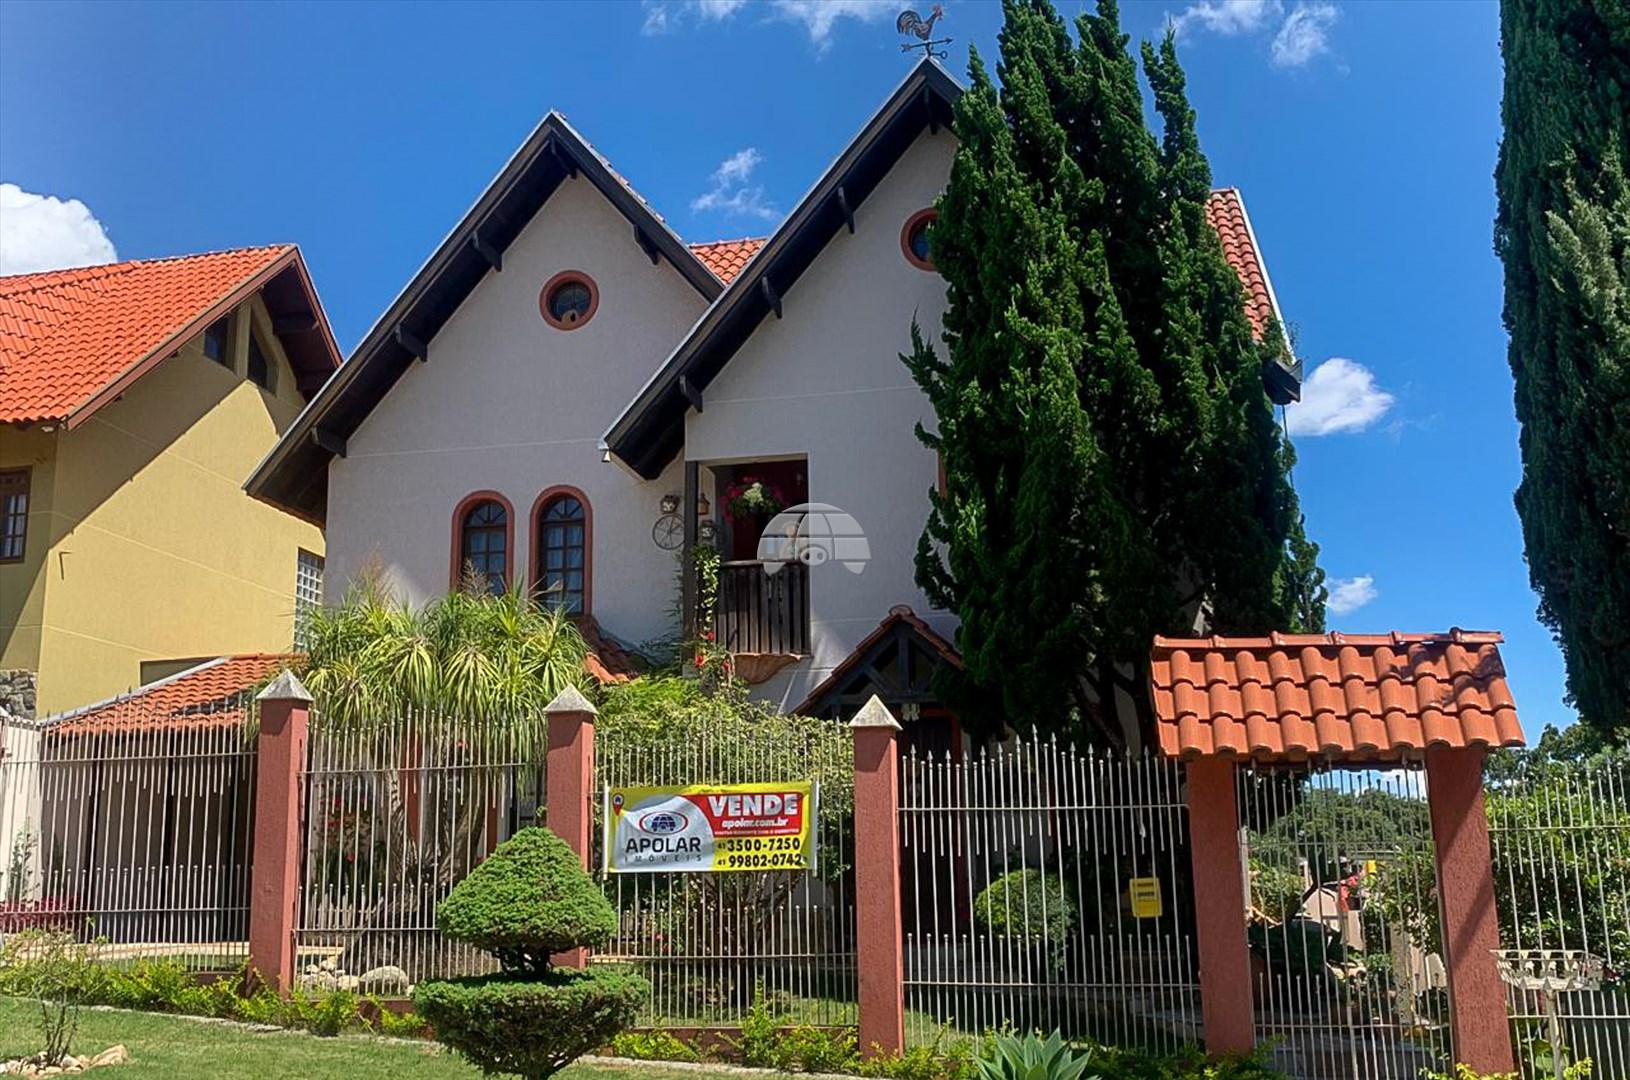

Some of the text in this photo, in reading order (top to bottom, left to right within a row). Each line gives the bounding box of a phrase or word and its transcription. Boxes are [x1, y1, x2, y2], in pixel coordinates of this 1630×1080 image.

[708, 793, 798, 817] VENDE
[721, 817, 789, 829] apolar.com.br
[625, 837, 702, 853] APOLAR
[727, 837, 800, 852] 3500-7250
[728, 853, 802, 868] 99802-0742
